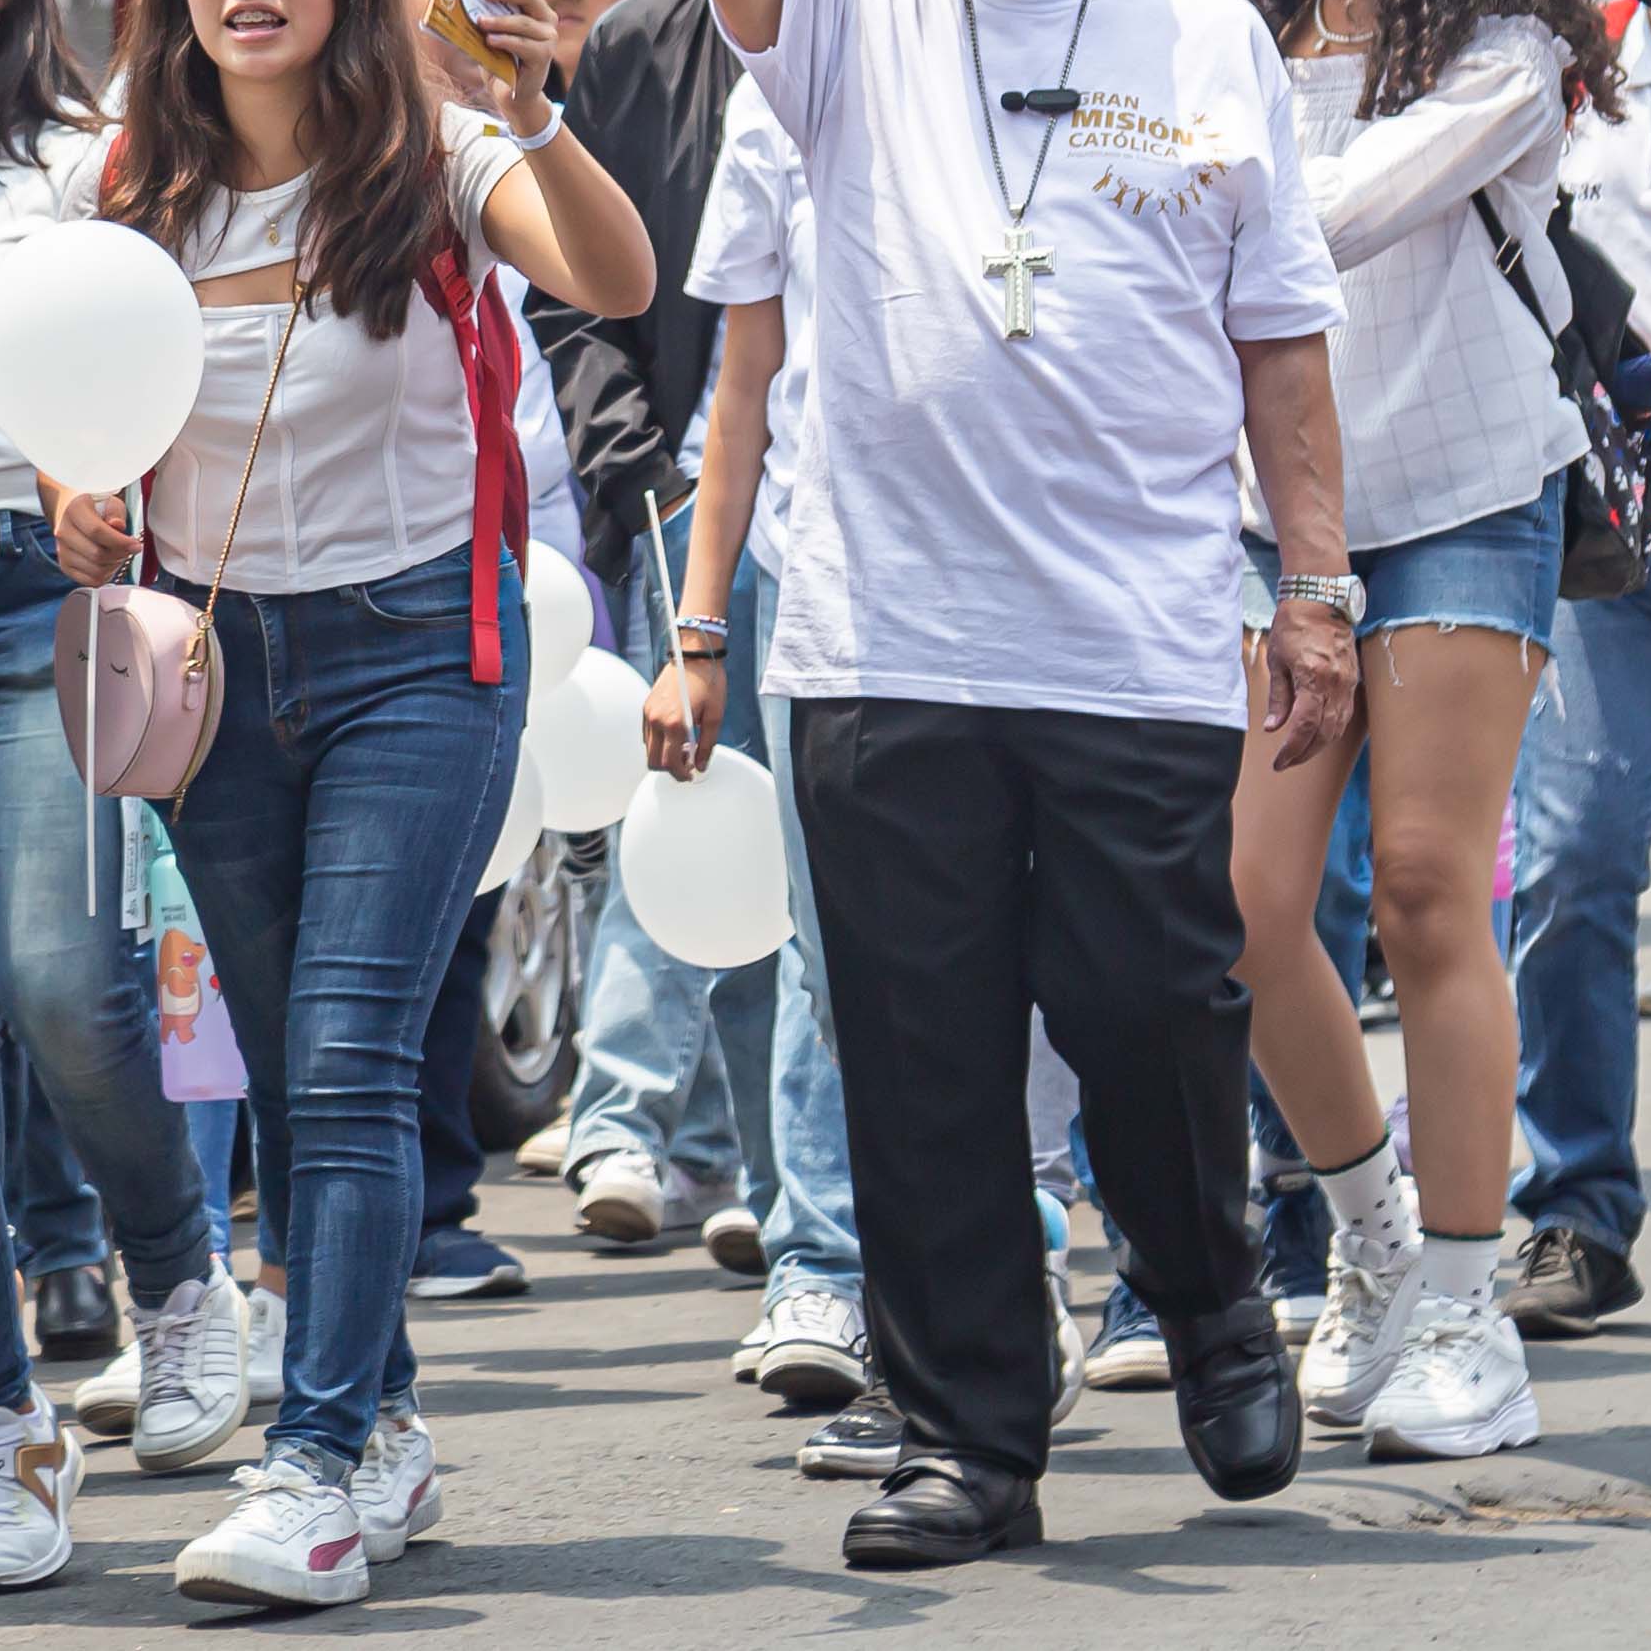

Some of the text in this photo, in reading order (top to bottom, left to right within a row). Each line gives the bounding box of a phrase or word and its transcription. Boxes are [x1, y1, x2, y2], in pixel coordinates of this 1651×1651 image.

[1080, 90, 1140, 111] GRAN
[1070, 108, 1195, 147] MISIÓN
[1068, 130, 1180, 159] CATÓLICA
